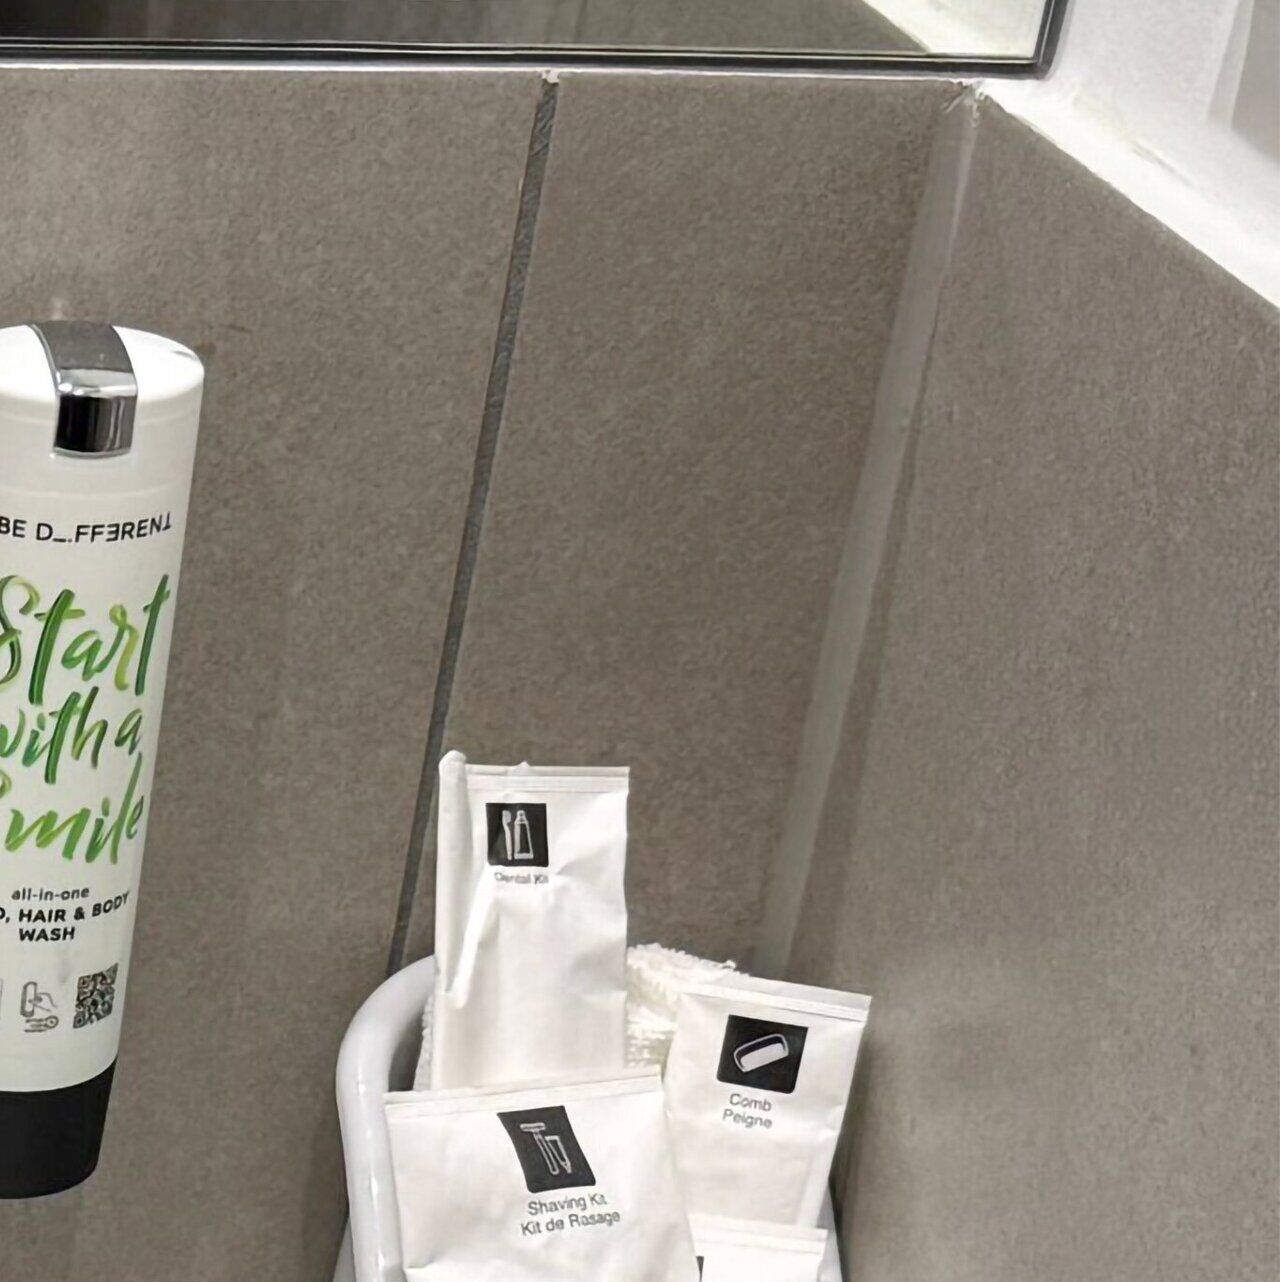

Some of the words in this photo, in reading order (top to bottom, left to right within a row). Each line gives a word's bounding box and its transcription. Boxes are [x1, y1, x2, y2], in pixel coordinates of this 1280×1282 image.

[114, 707, 143, 756] a
[10, 887, 90, 902] all-in-one
[18, 908, 67, 924] HAIR
[73, 906, 86, 921] &
[91, 889, 130, 918] BODY
[18, 926, 76, 942] WASH
[729, 1092, 772, 1112] Comb
[722, 1108, 773, 1129] Peigne
[527, 1194, 587, 1216] Shaving
[588, 1192, 608, 1206] Kit
[520, 1220, 543, 1237] Kit
[545, 1217, 565, 1232] de
